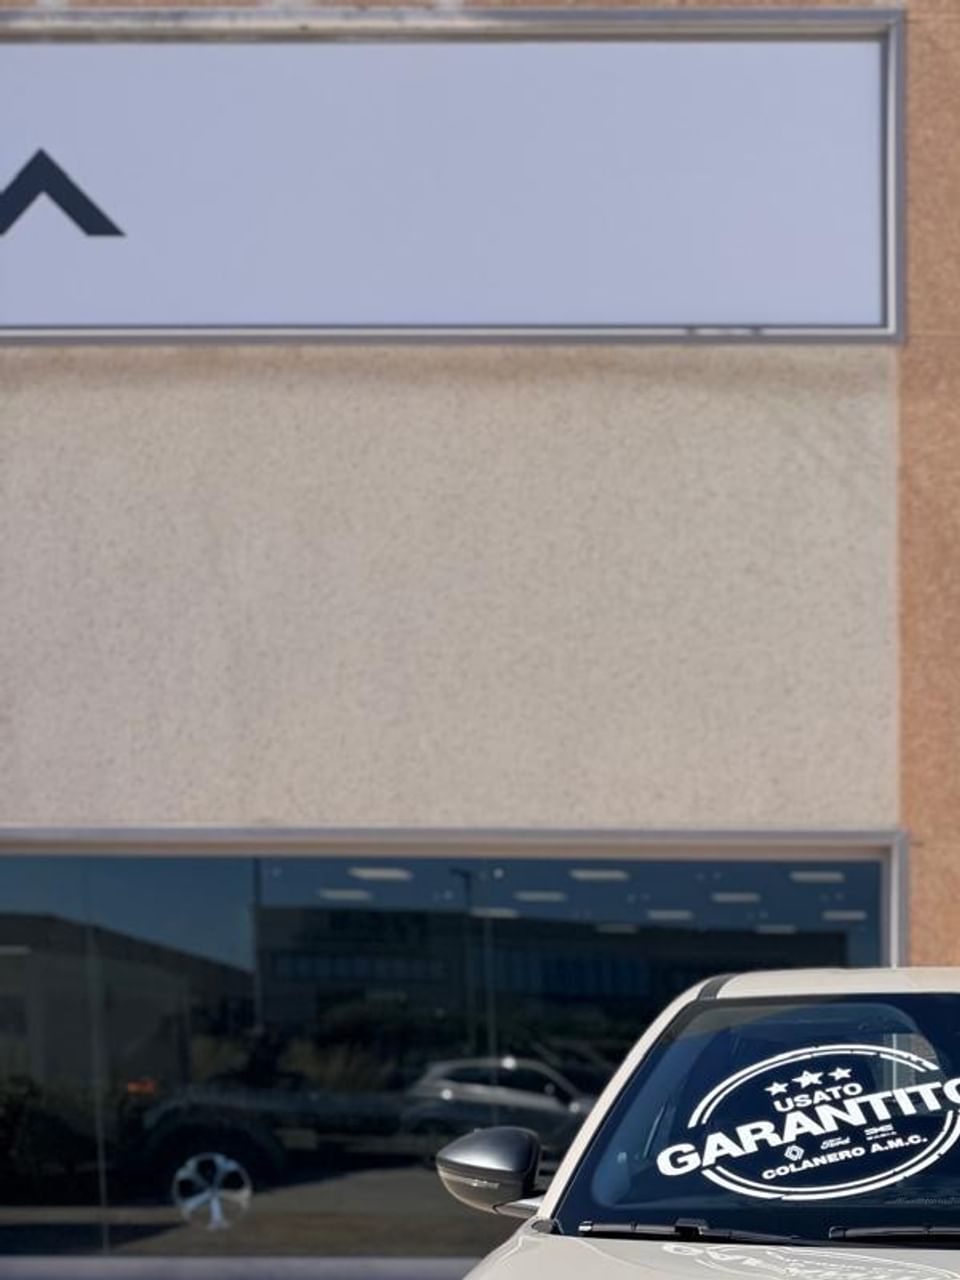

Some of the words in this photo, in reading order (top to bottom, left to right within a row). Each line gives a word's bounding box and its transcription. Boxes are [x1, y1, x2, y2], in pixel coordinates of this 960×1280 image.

[773, 1082, 863, 1113] USATO
[762, 1147, 866, 1180] COLANERO
[870, 1134, 928, 1154] A.M.C.
